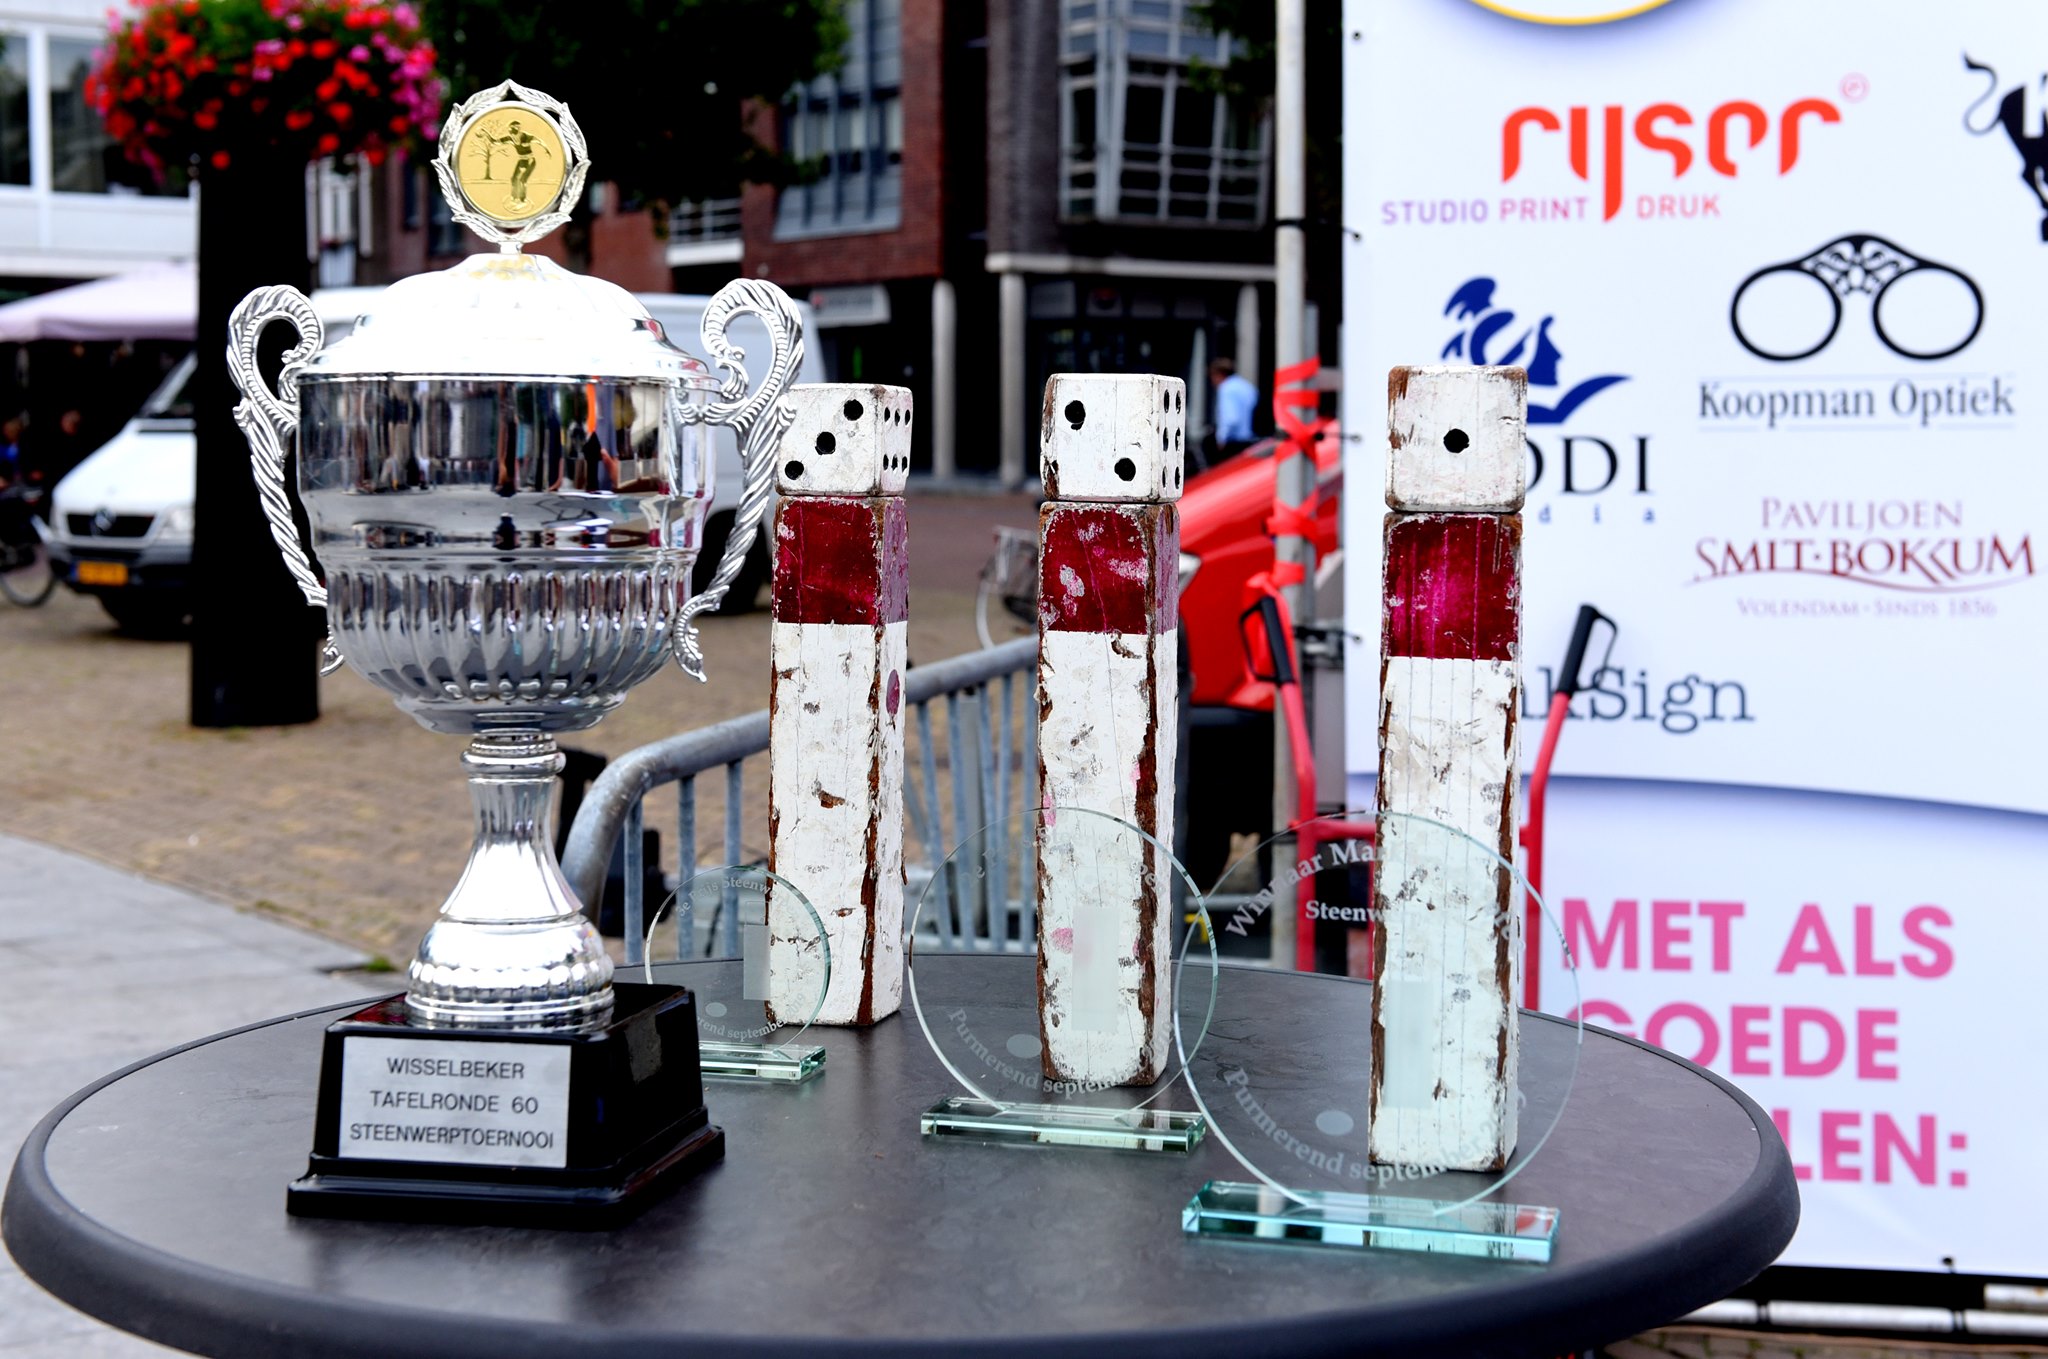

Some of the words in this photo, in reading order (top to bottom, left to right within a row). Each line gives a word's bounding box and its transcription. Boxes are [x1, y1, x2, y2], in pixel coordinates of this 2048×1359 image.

[1381, 199, 1489, 225] STUDIO
[1499, 196, 1588, 221] PRINT
[1636, 194, 1721, 219] DRUK
[1699, 381, 1876, 429] Koopman
[1890, 376, 2015, 428] Optiek
[1761, 497, 1963, 531] PAVILJOEN
[1225, 853, 1324, 937] Winnaar
[1561, 898, 1745, 972] MET
[1776, 904, 1956, 979] ALS
[386, 1057, 525, 1080] WISSELBEKER
[950, 1008, 1039, 1090] Purmerend
[370, 1090, 500, 1113] TAFELRONDE
[511, 1096, 539, 1115] 60
[1224, 1067, 1345, 1177] Purmerend
[350, 1123, 554, 1149] STEENWERPTOERNOOI
